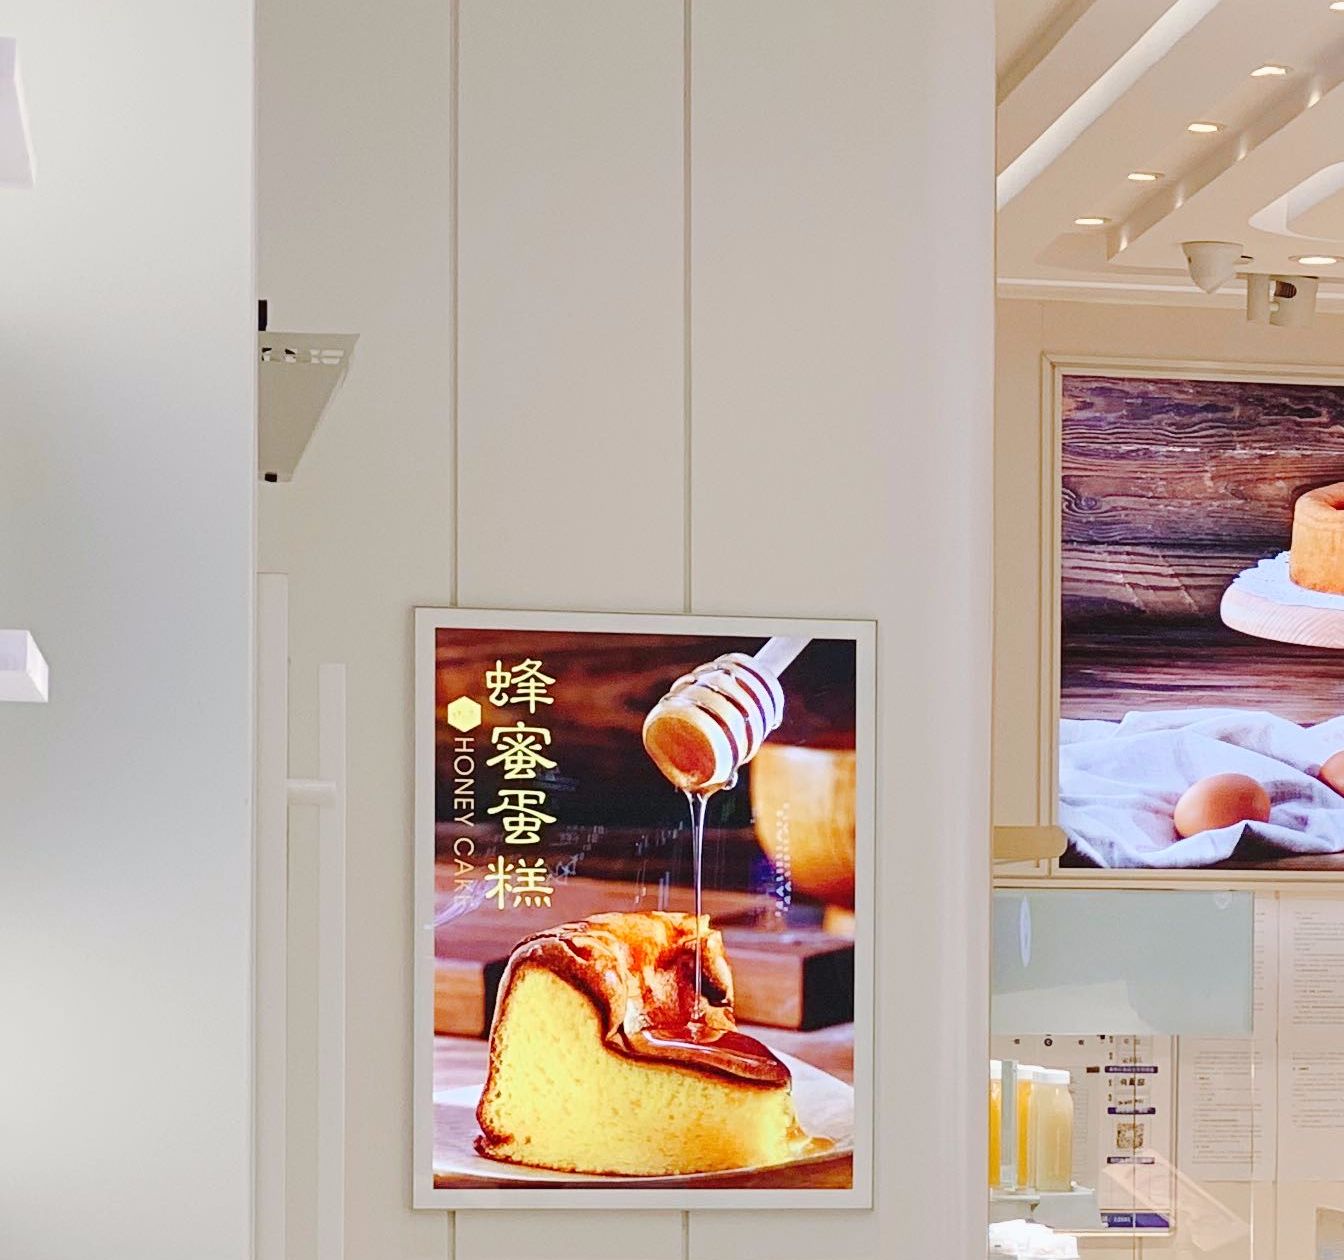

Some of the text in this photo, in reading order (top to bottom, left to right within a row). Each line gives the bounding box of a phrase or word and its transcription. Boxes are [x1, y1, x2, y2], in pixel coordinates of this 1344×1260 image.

[454, 737, 475, 827] HONEY
[485, 658, 557, 910] 蜂蜜蛋糕
